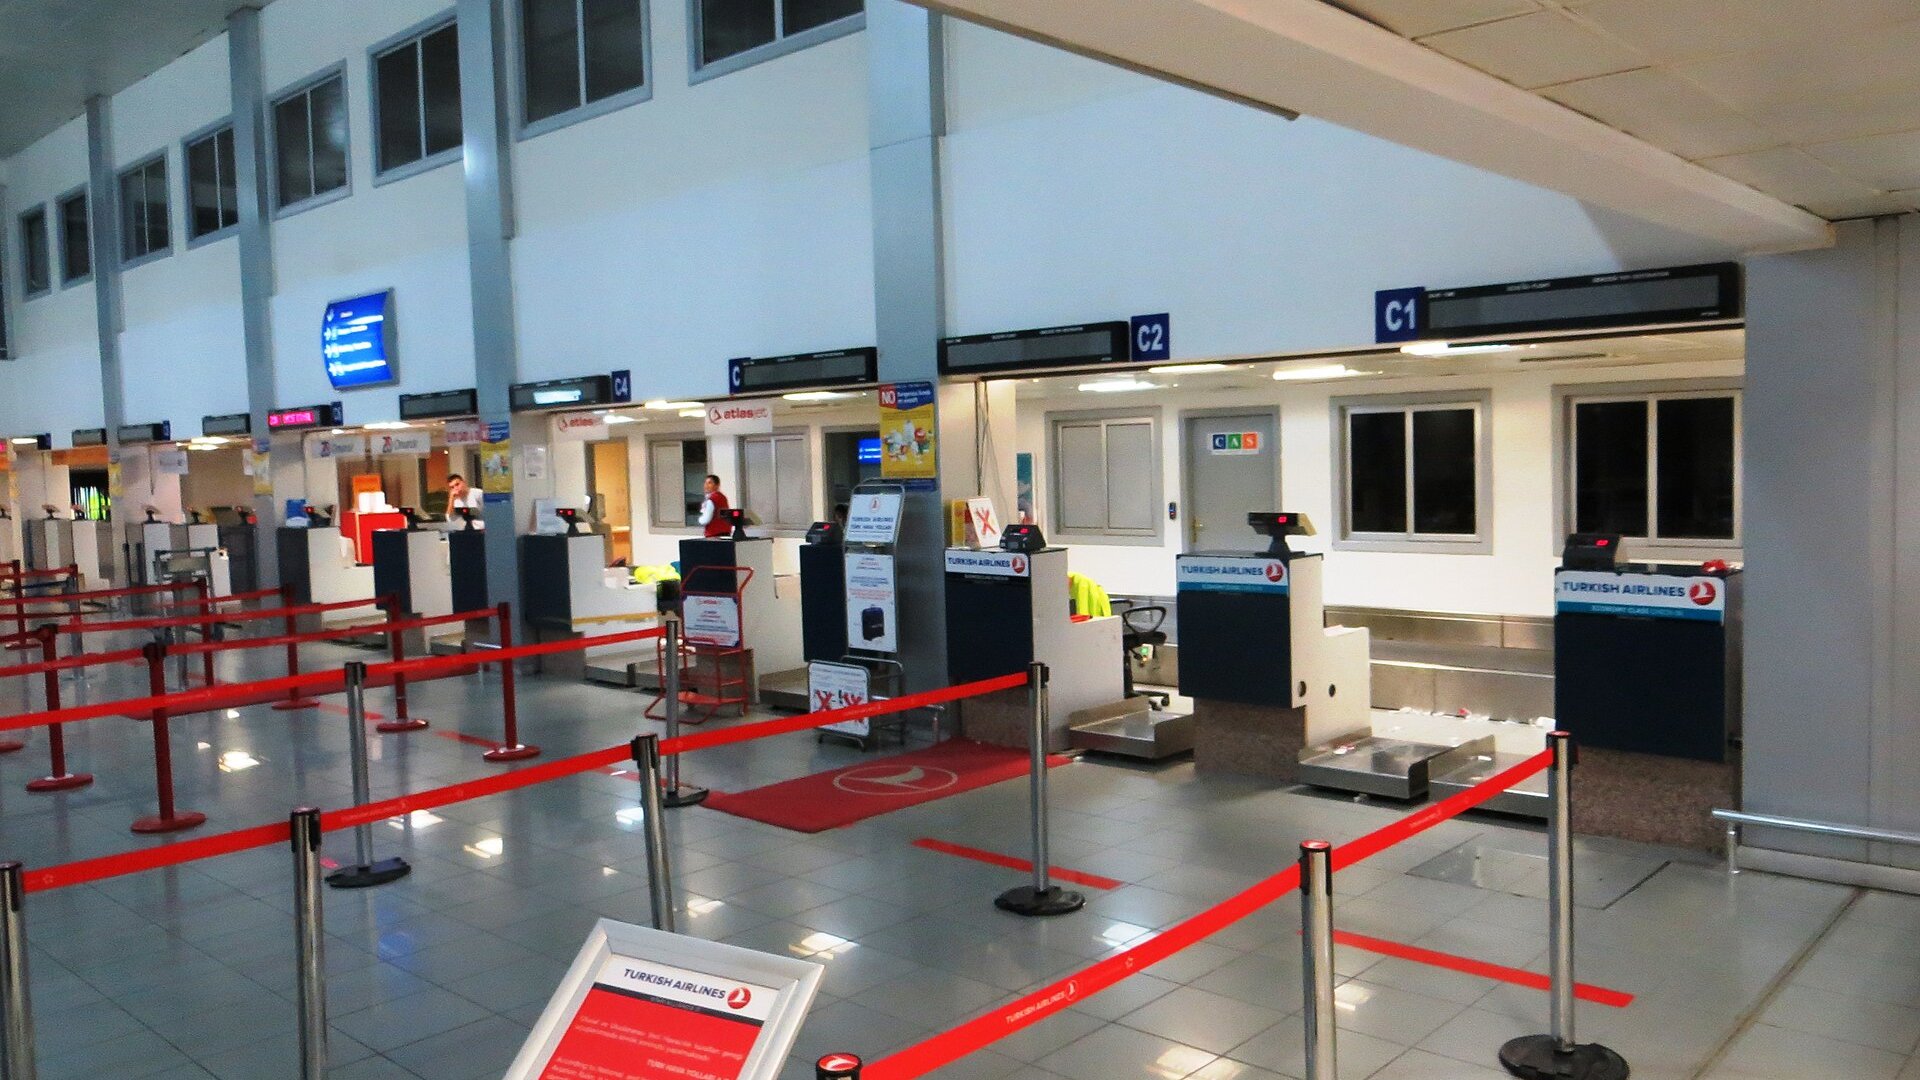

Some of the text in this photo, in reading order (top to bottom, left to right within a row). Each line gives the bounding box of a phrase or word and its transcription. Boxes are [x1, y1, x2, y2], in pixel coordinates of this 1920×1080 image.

[1385, 299, 1415, 331] C1
[1137, 324, 1163, 351] C2
[615, 377, 628, 396] C4
[881, 390, 896, 404] NO
[723, 407, 768, 419] atlasjet
[947, 557, 1010, 567] TURKISH AIRLINES
[1181, 565, 1263, 575] TURKISH AIRLINES
[1563, 581, 1685, 597] TURKISH AIRLINES
[624, 968, 727, 999] TURKISH AIRLINES
[1006, 990, 1066, 1024] TURKISH AIRLINES
